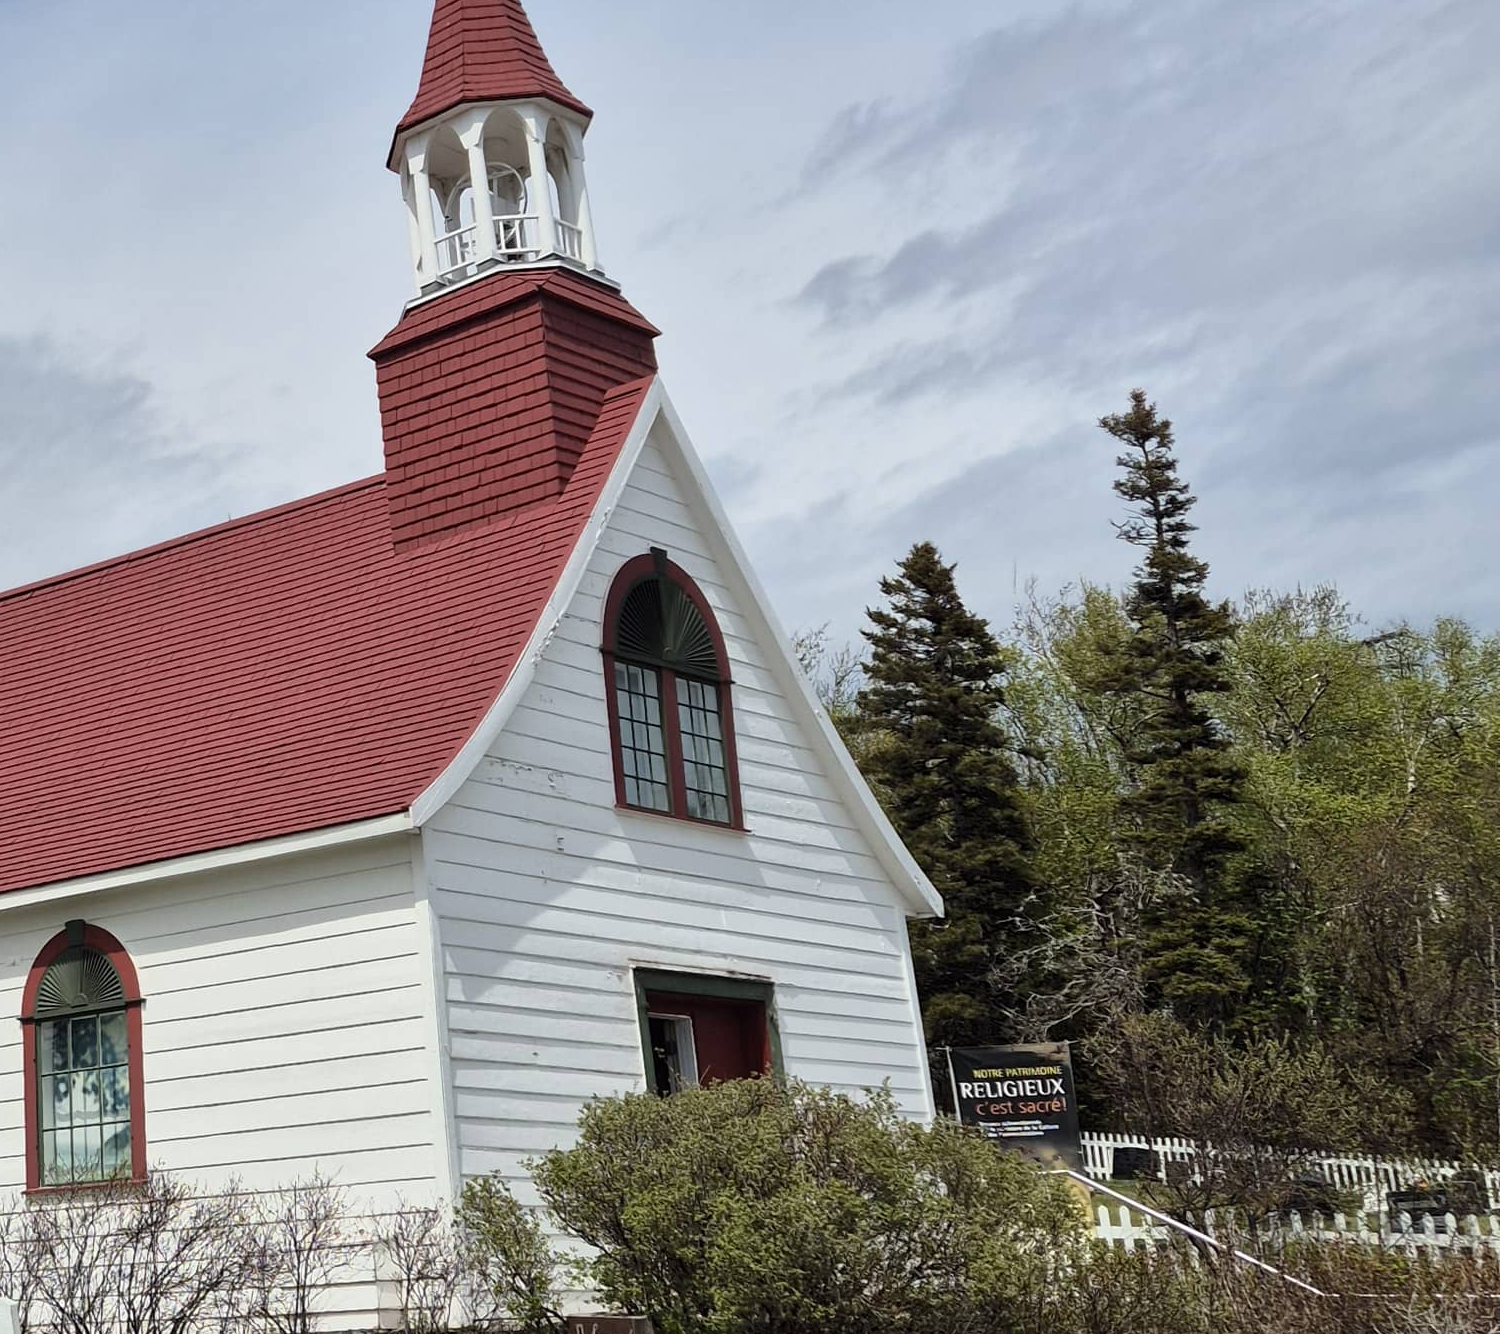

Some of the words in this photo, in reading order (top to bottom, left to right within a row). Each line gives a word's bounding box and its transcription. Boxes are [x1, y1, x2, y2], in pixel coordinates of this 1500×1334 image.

[972, 1068, 1004, 1079] NOTRE
[1006, 1065, 1062, 1077] PATRIMOINE
[959, 1078, 1065, 1099] RELIGIEUX
[976, 1101, 1014, 1116] c'est
[1018, 1097, 1067, 1114] sacré!
